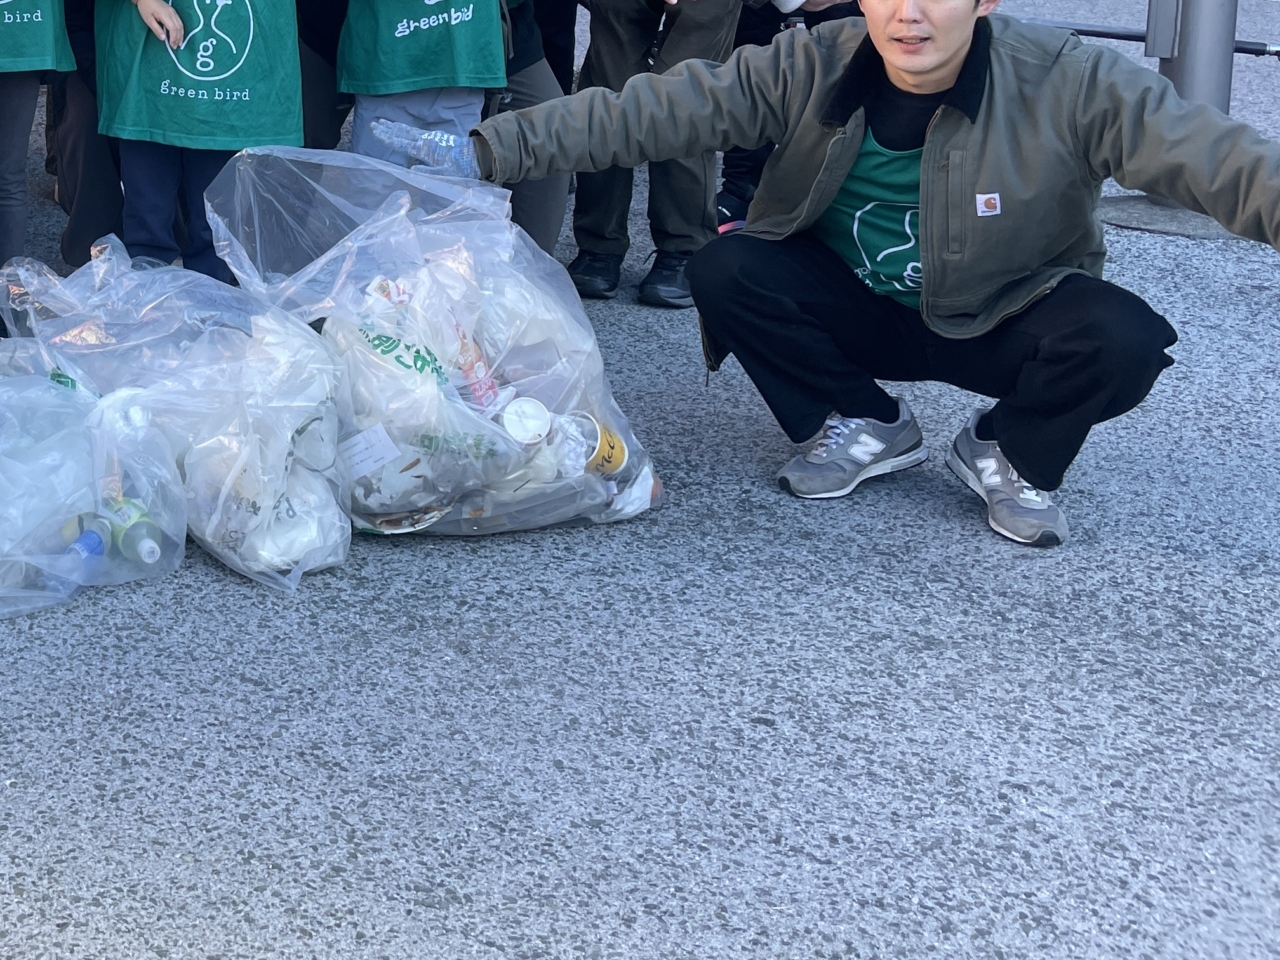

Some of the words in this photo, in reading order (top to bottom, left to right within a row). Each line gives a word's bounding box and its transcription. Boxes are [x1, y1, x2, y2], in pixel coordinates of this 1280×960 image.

[3, 8, 43, 24] bird
[395, 12, 449, 38] green
[160, 80, 209, 100] green
[213, 86, 250, 102] bird
